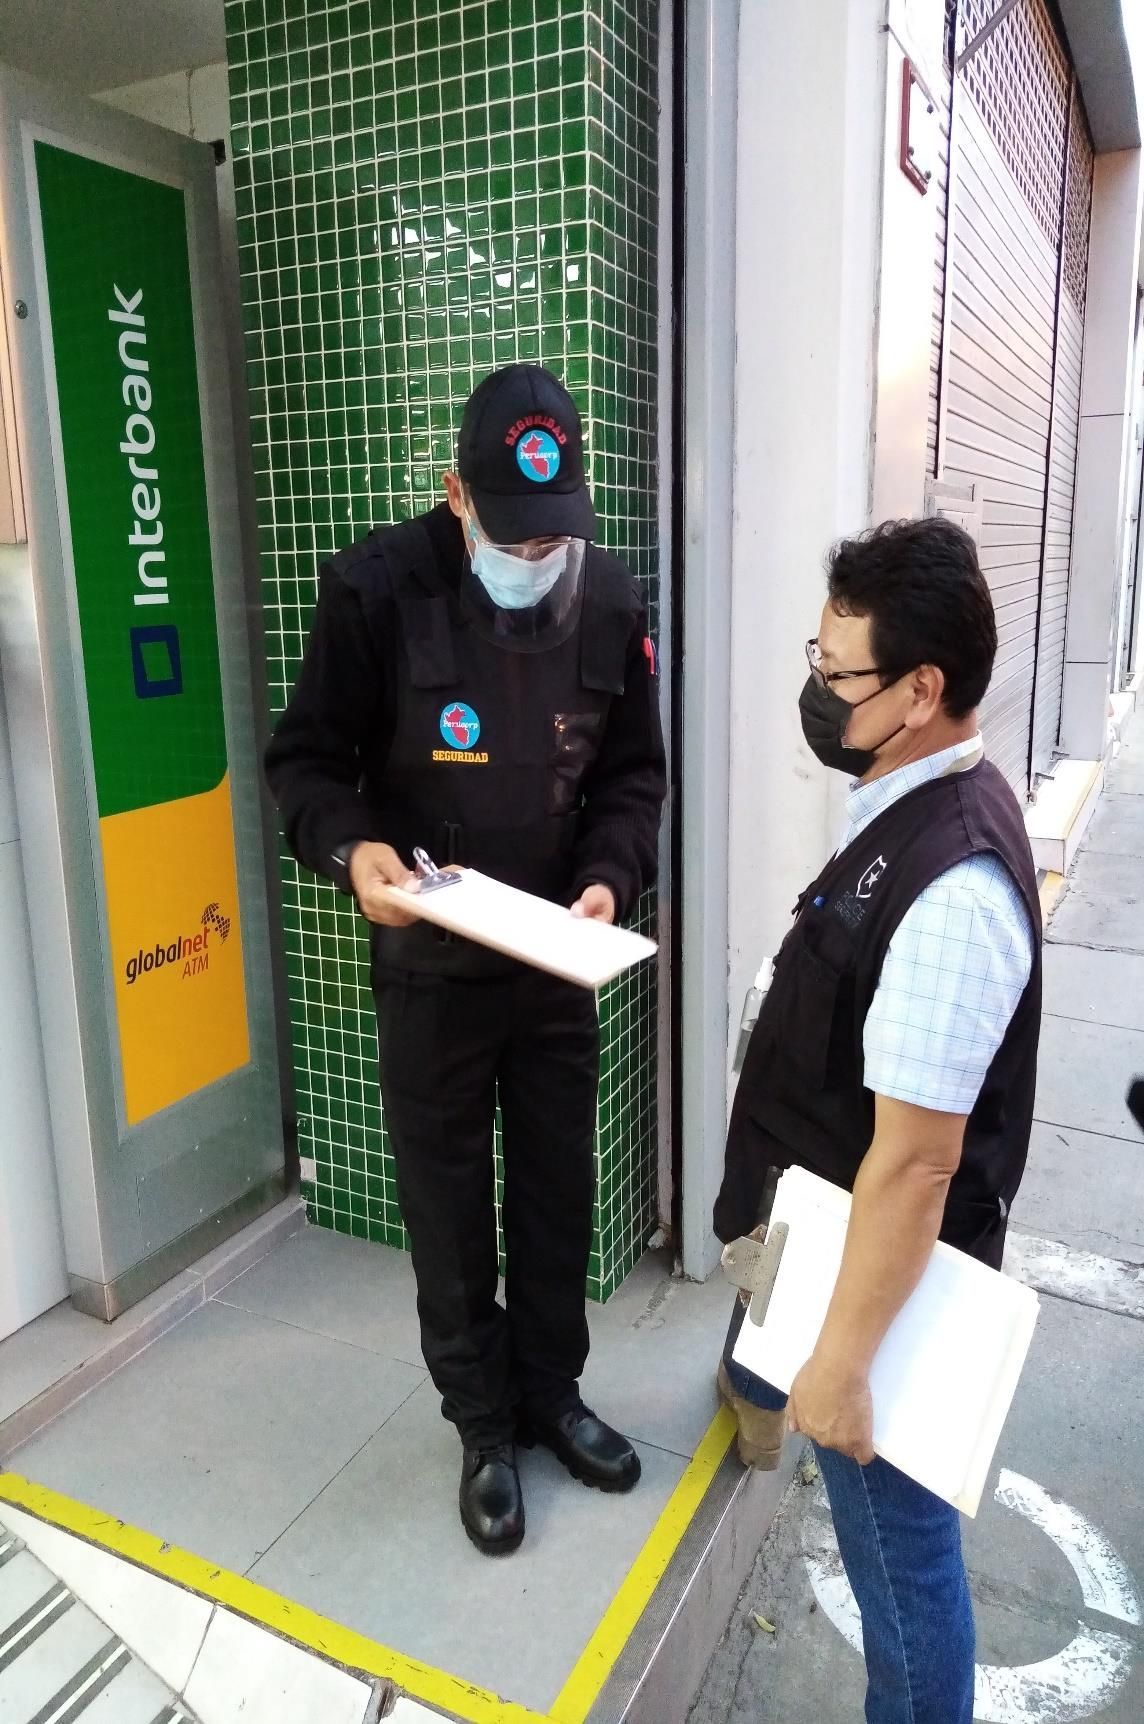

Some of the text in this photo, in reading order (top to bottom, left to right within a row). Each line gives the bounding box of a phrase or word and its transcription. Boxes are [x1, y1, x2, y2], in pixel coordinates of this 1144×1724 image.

[108, 282, 169, 606] Interbank
[504, 415, 567, 446] SEGURIDAD
[432, 750, 489, 763] SEGURIDAD
[126, 926, 210, 985] globalnet
[182, 953, 209, 980] ATM
